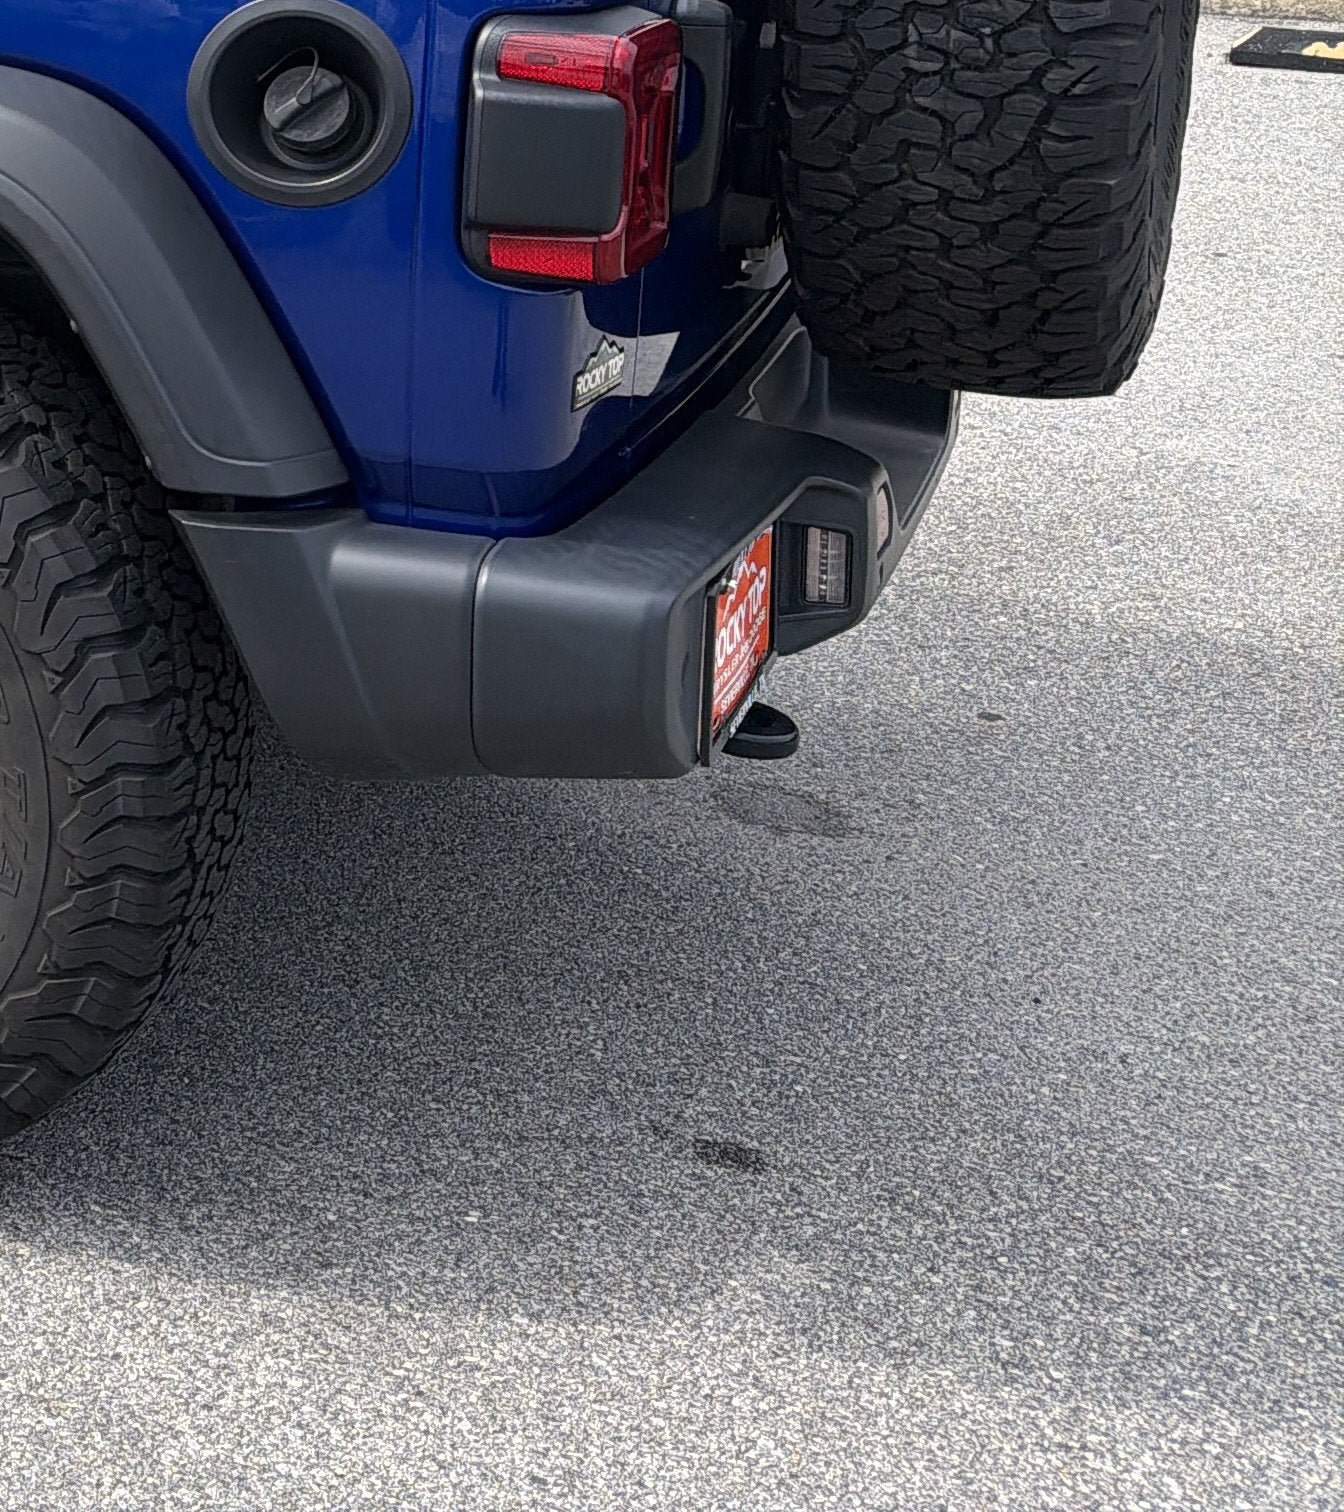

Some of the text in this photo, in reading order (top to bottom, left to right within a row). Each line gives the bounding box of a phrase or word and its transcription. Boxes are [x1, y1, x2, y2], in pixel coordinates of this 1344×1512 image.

[576, 352, 625, 396] ROCKY TOP
[747, 566, 767, 624] TOP
